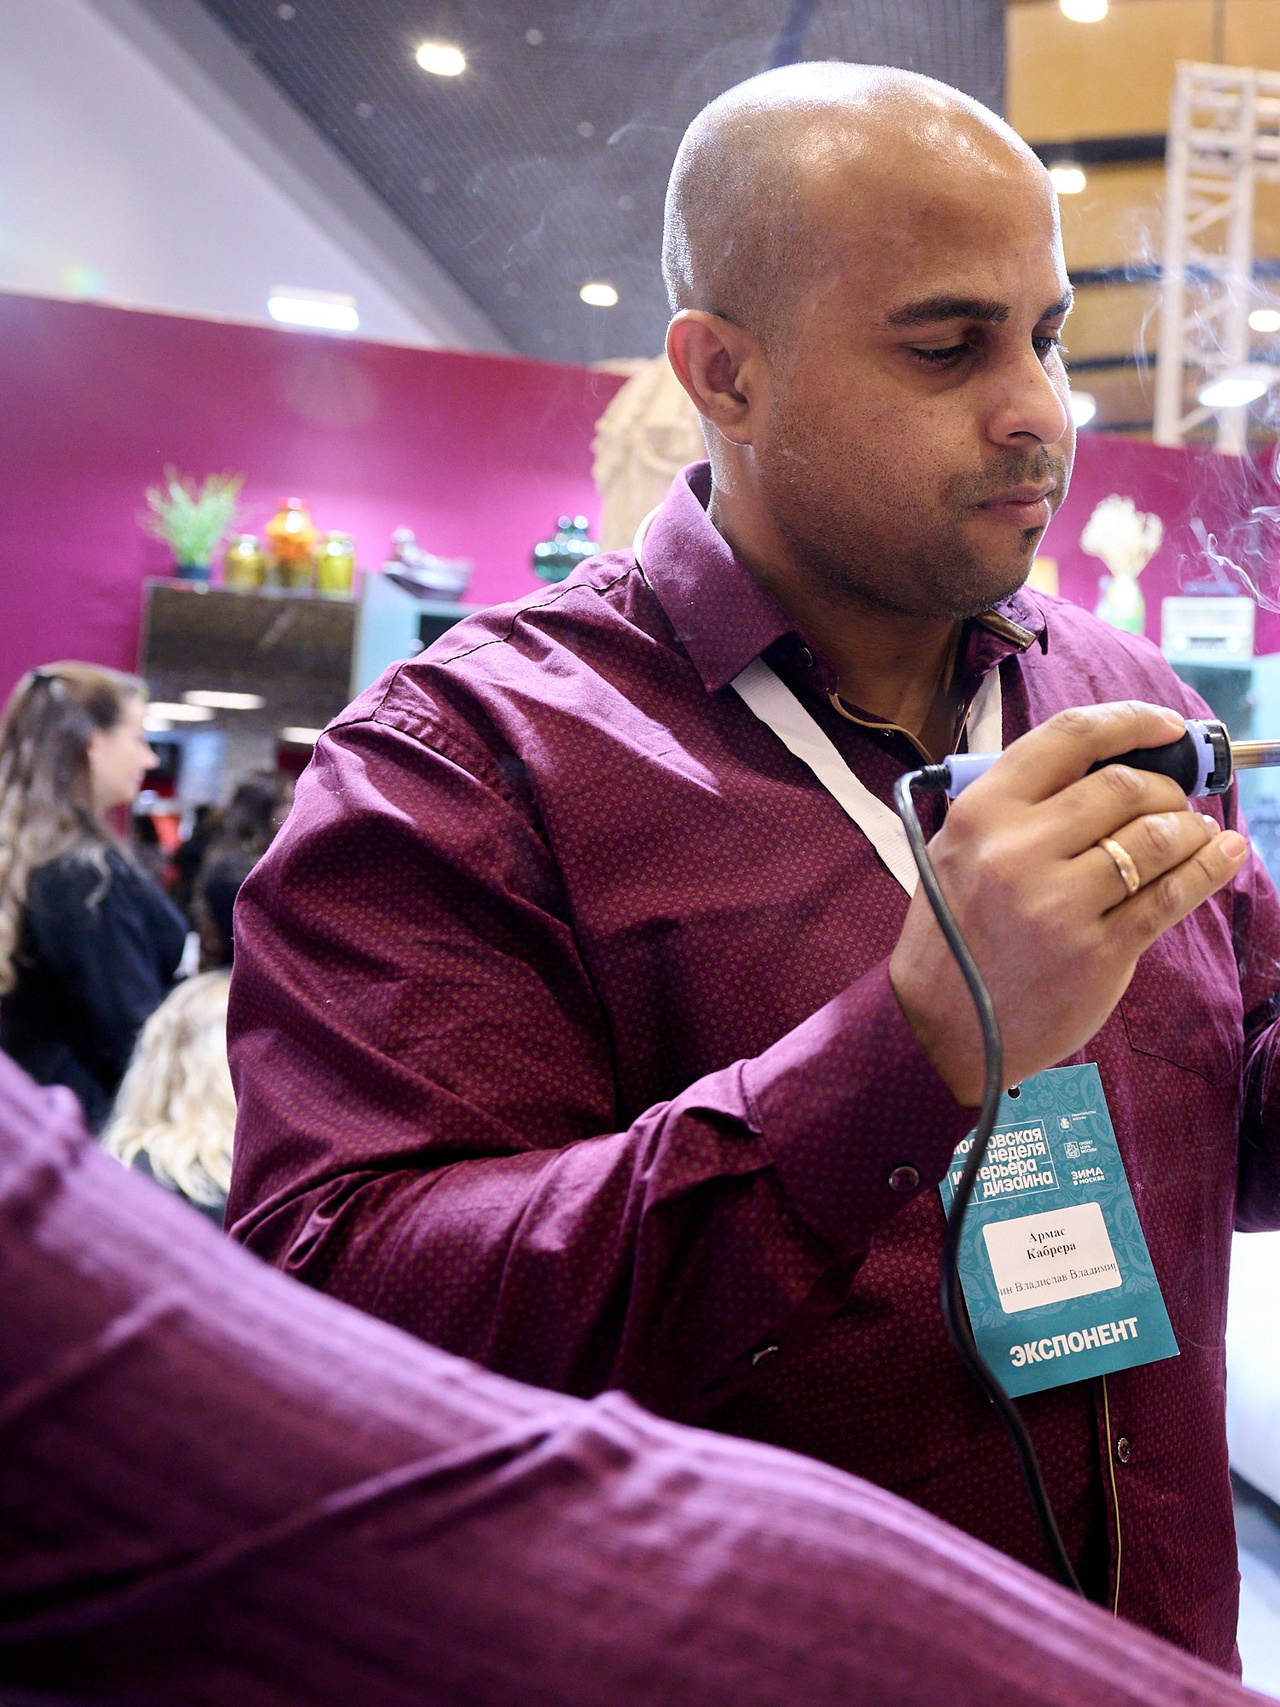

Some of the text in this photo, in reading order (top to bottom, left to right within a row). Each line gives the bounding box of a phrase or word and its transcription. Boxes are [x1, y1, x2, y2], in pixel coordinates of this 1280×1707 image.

[953, 1128, 1043, 1155] осовская
[987, 1142, 1046, 1164] неделя
[952, 1159, 1038, 1186] итерьера
[1071, 1167, 1104, 1180] ЗИМА
[1079, 1175, 1105, 1185] МОСКВЕ
[983, 1171, 1054, 1198] дизайна
[1029, 1228, 1066, 1243] Армас
[1026, 1242, 1077, 1260] Кабрера
[1015, 1275, 1068, 1293] Владислав
[1009, 1317, 1138, 1367] ЭКСПОНЕНТ
